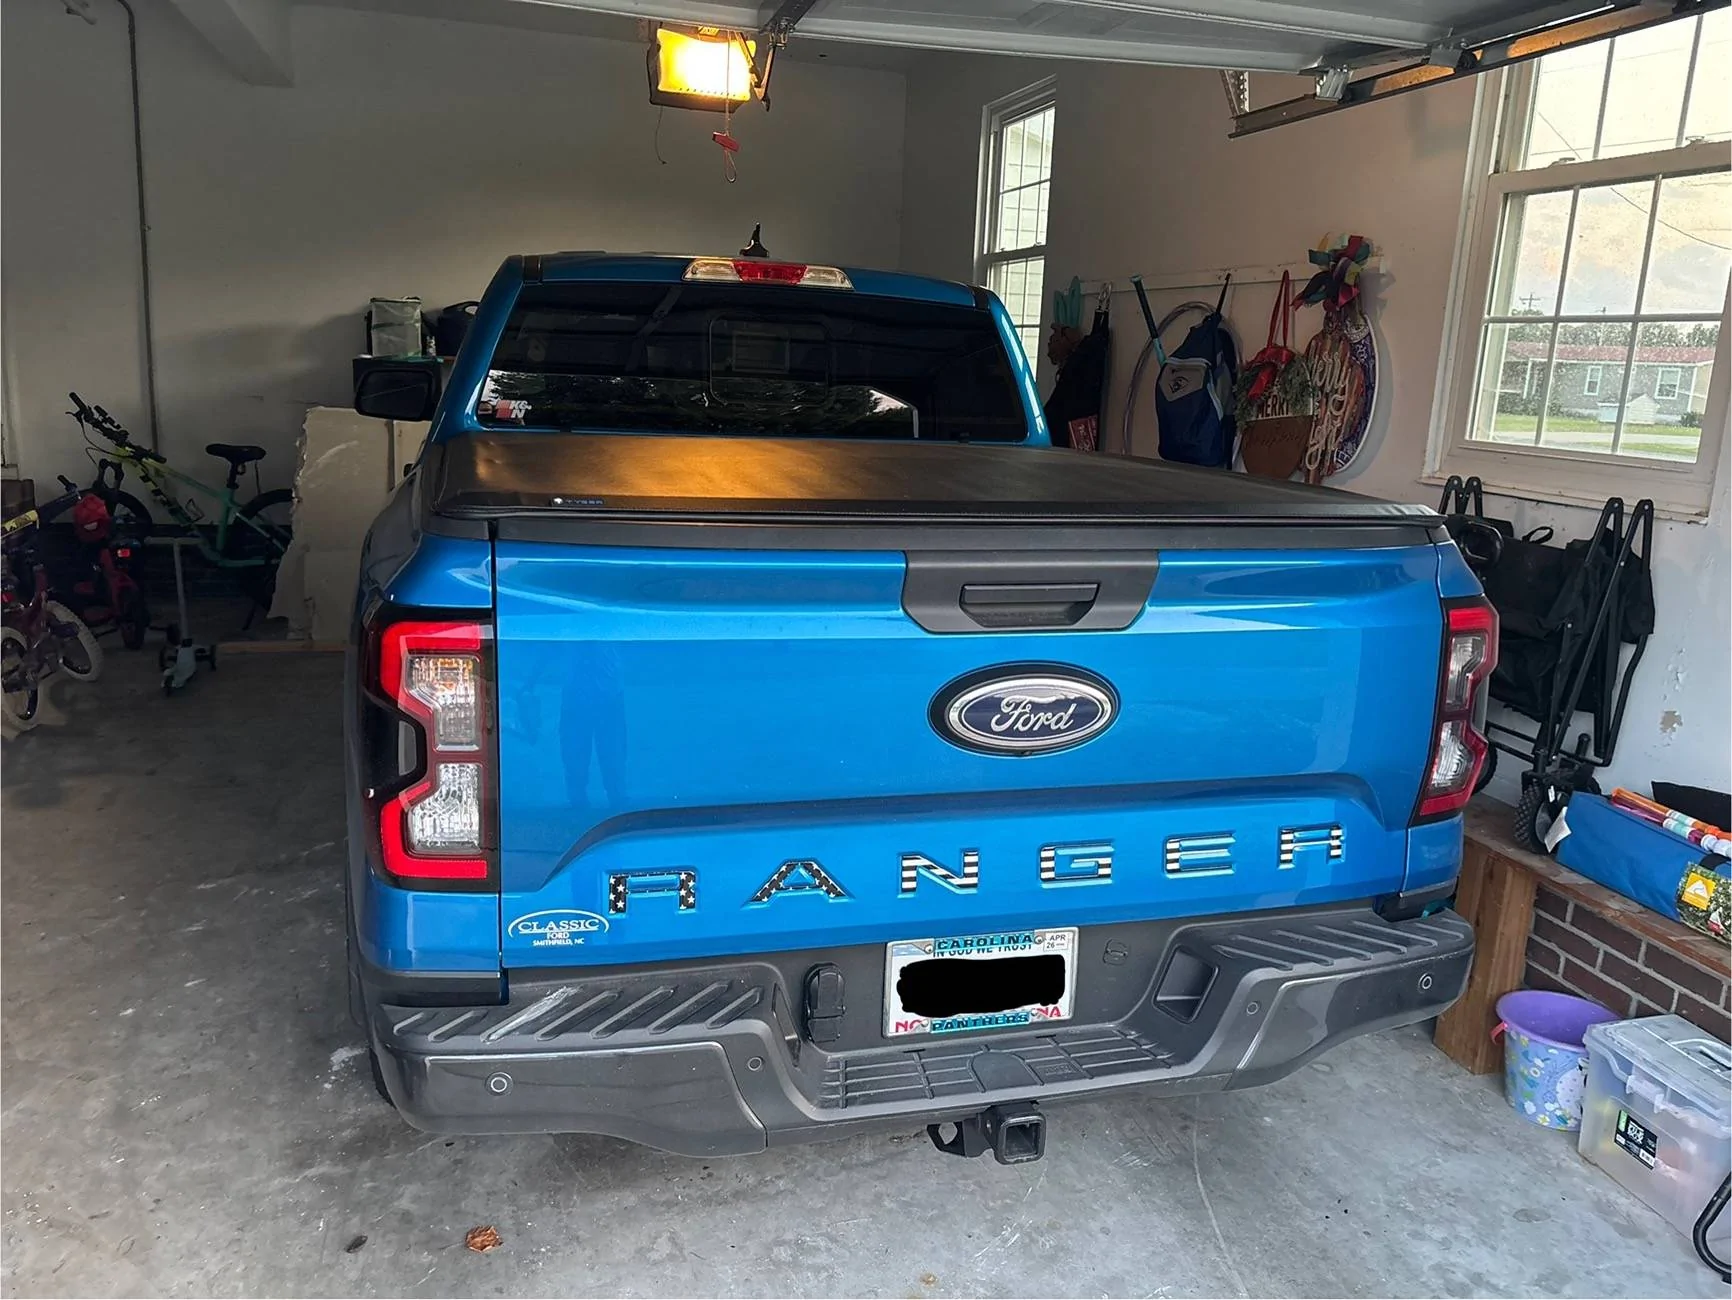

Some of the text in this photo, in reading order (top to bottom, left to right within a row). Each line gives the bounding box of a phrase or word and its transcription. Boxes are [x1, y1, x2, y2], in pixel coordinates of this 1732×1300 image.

[990, 695, 1078, 733] Ford
[607, 823, 1346, 915] RANGER
[517, 918, 600, 933] CLASSIC
[547, 931, 570, 940] FORD
[574, 937, 585, 946] NC
[937, 933, 1033, 950] CAROLINA
[1049, 934, 1067, 942] APR
[1046, 941, 1056, 949] 26
[932, 1014, 1030, 1032] PANTHERS
